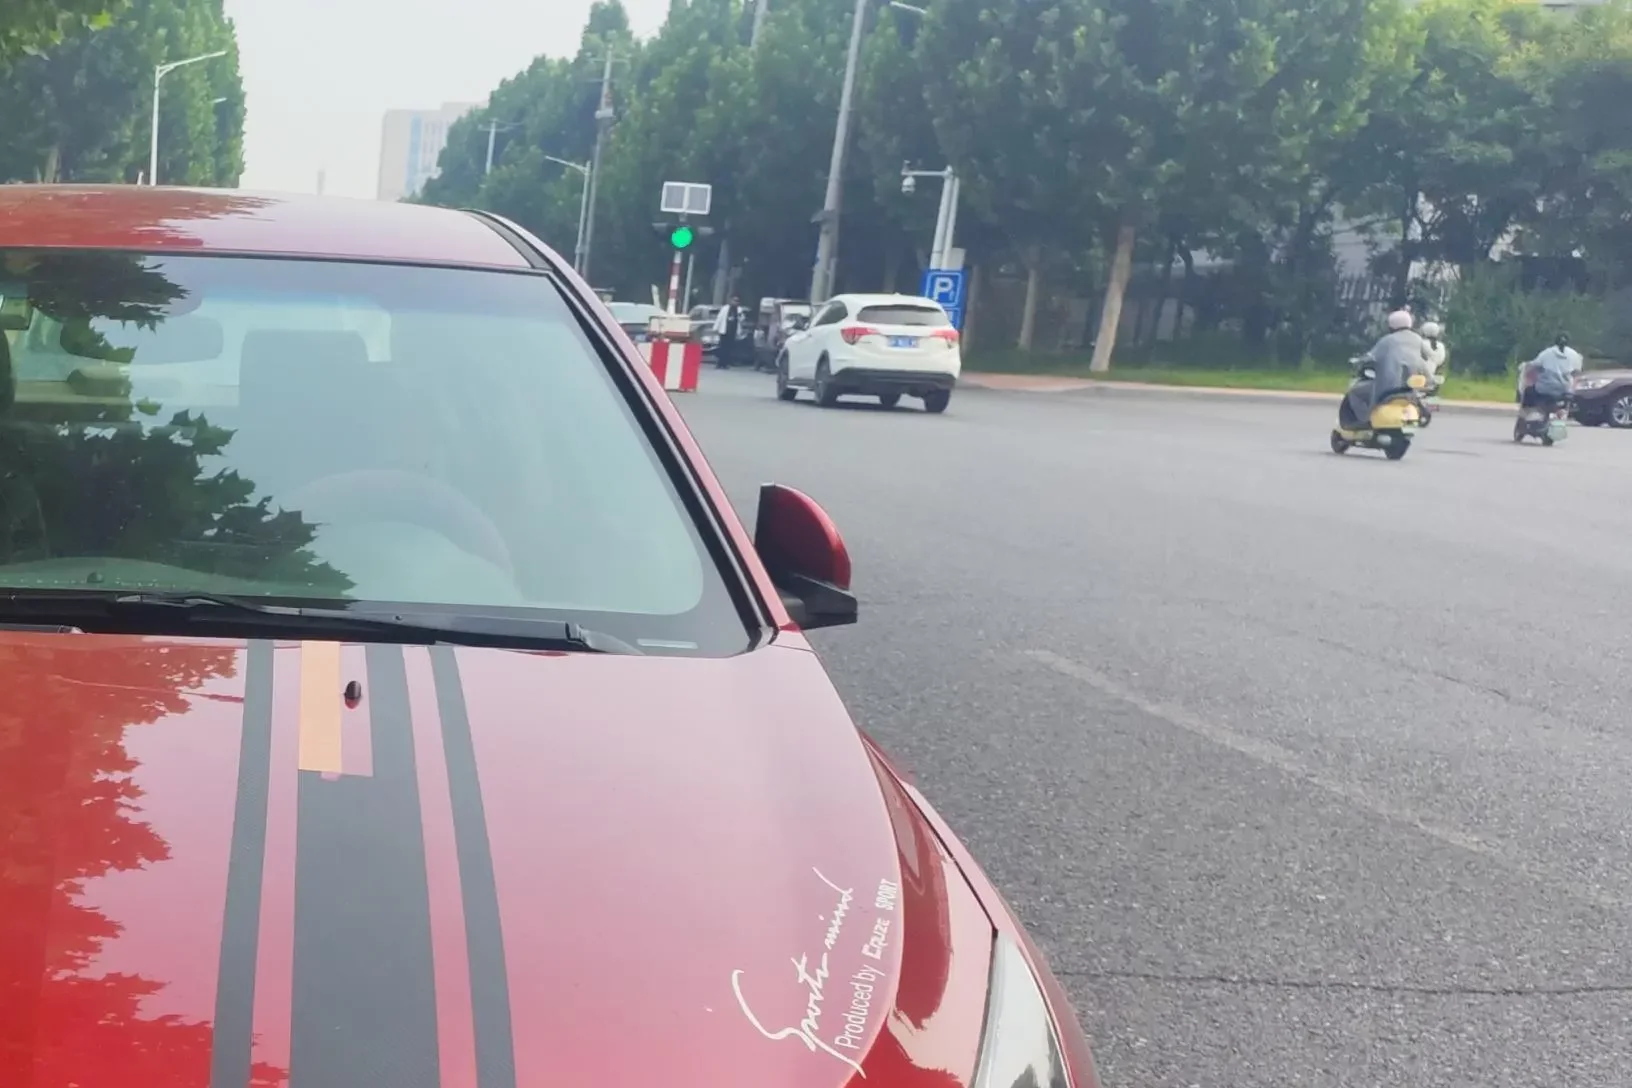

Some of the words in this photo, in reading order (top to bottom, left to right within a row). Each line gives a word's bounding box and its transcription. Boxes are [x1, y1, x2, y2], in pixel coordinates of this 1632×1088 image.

[933, 276, 954, 301] P
[834, 980, 874, 1050] Produced
[875, 877, 898, 911] SPORT
